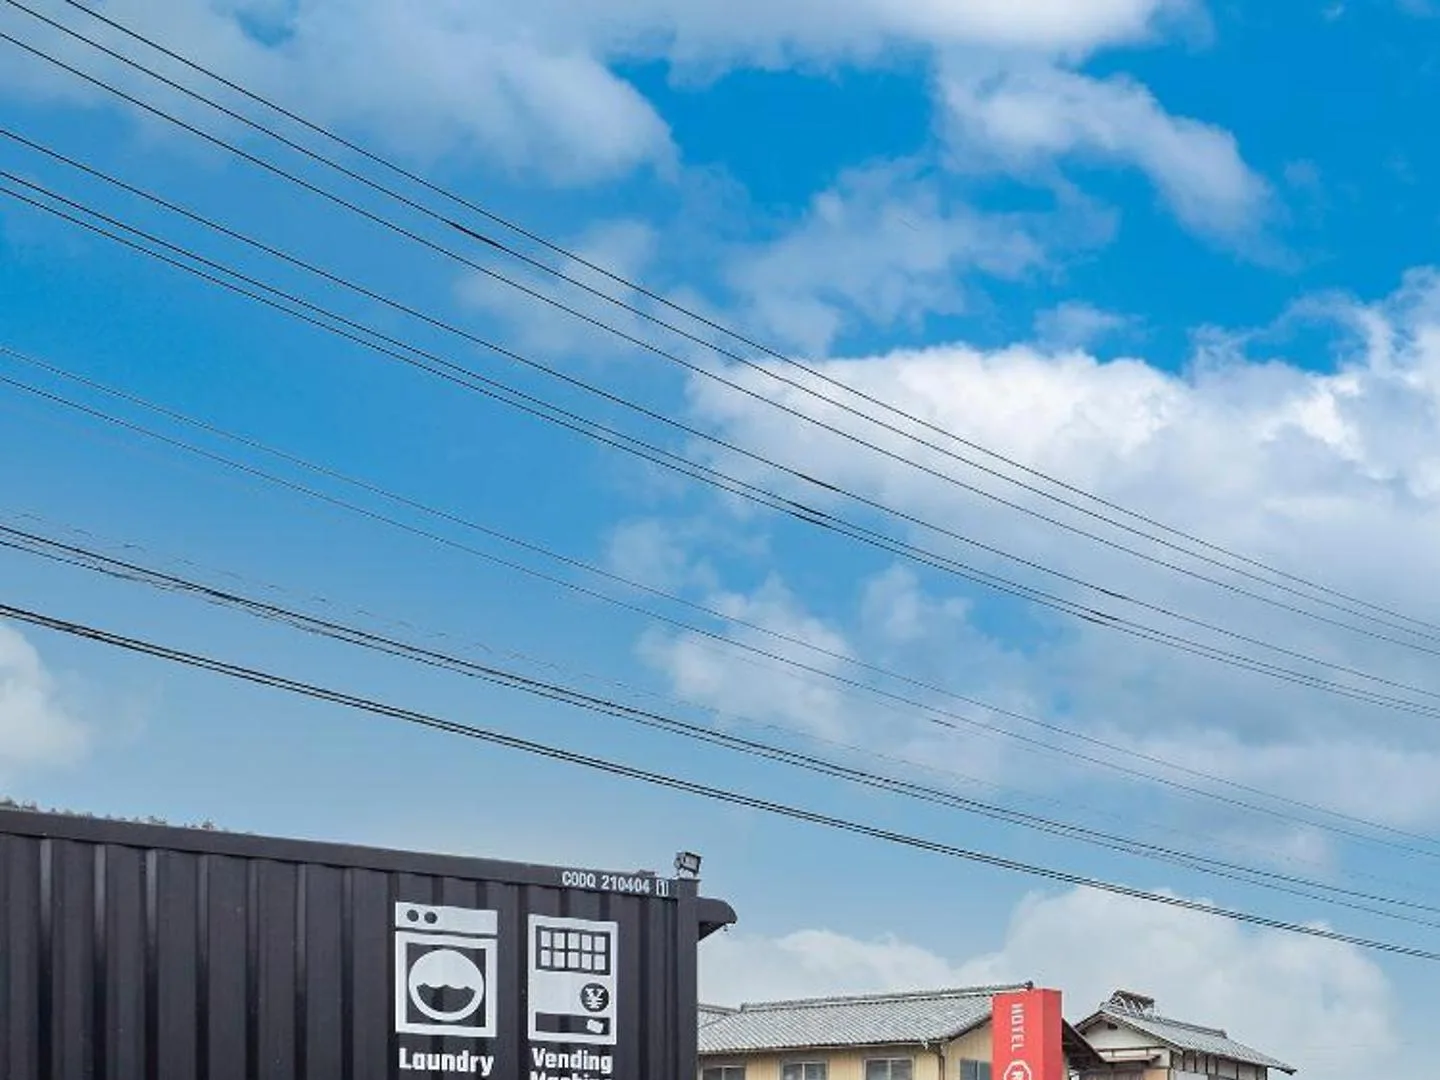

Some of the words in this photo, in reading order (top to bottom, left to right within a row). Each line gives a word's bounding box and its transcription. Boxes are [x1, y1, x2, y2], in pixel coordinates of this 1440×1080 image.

[601, 875, 650, 893] 210404
[1011, 1003, 1025, 1053] HOTEL
[400, 1048, 494, 1076] Laundry
[532, 1048, 613, 1073] Vending
